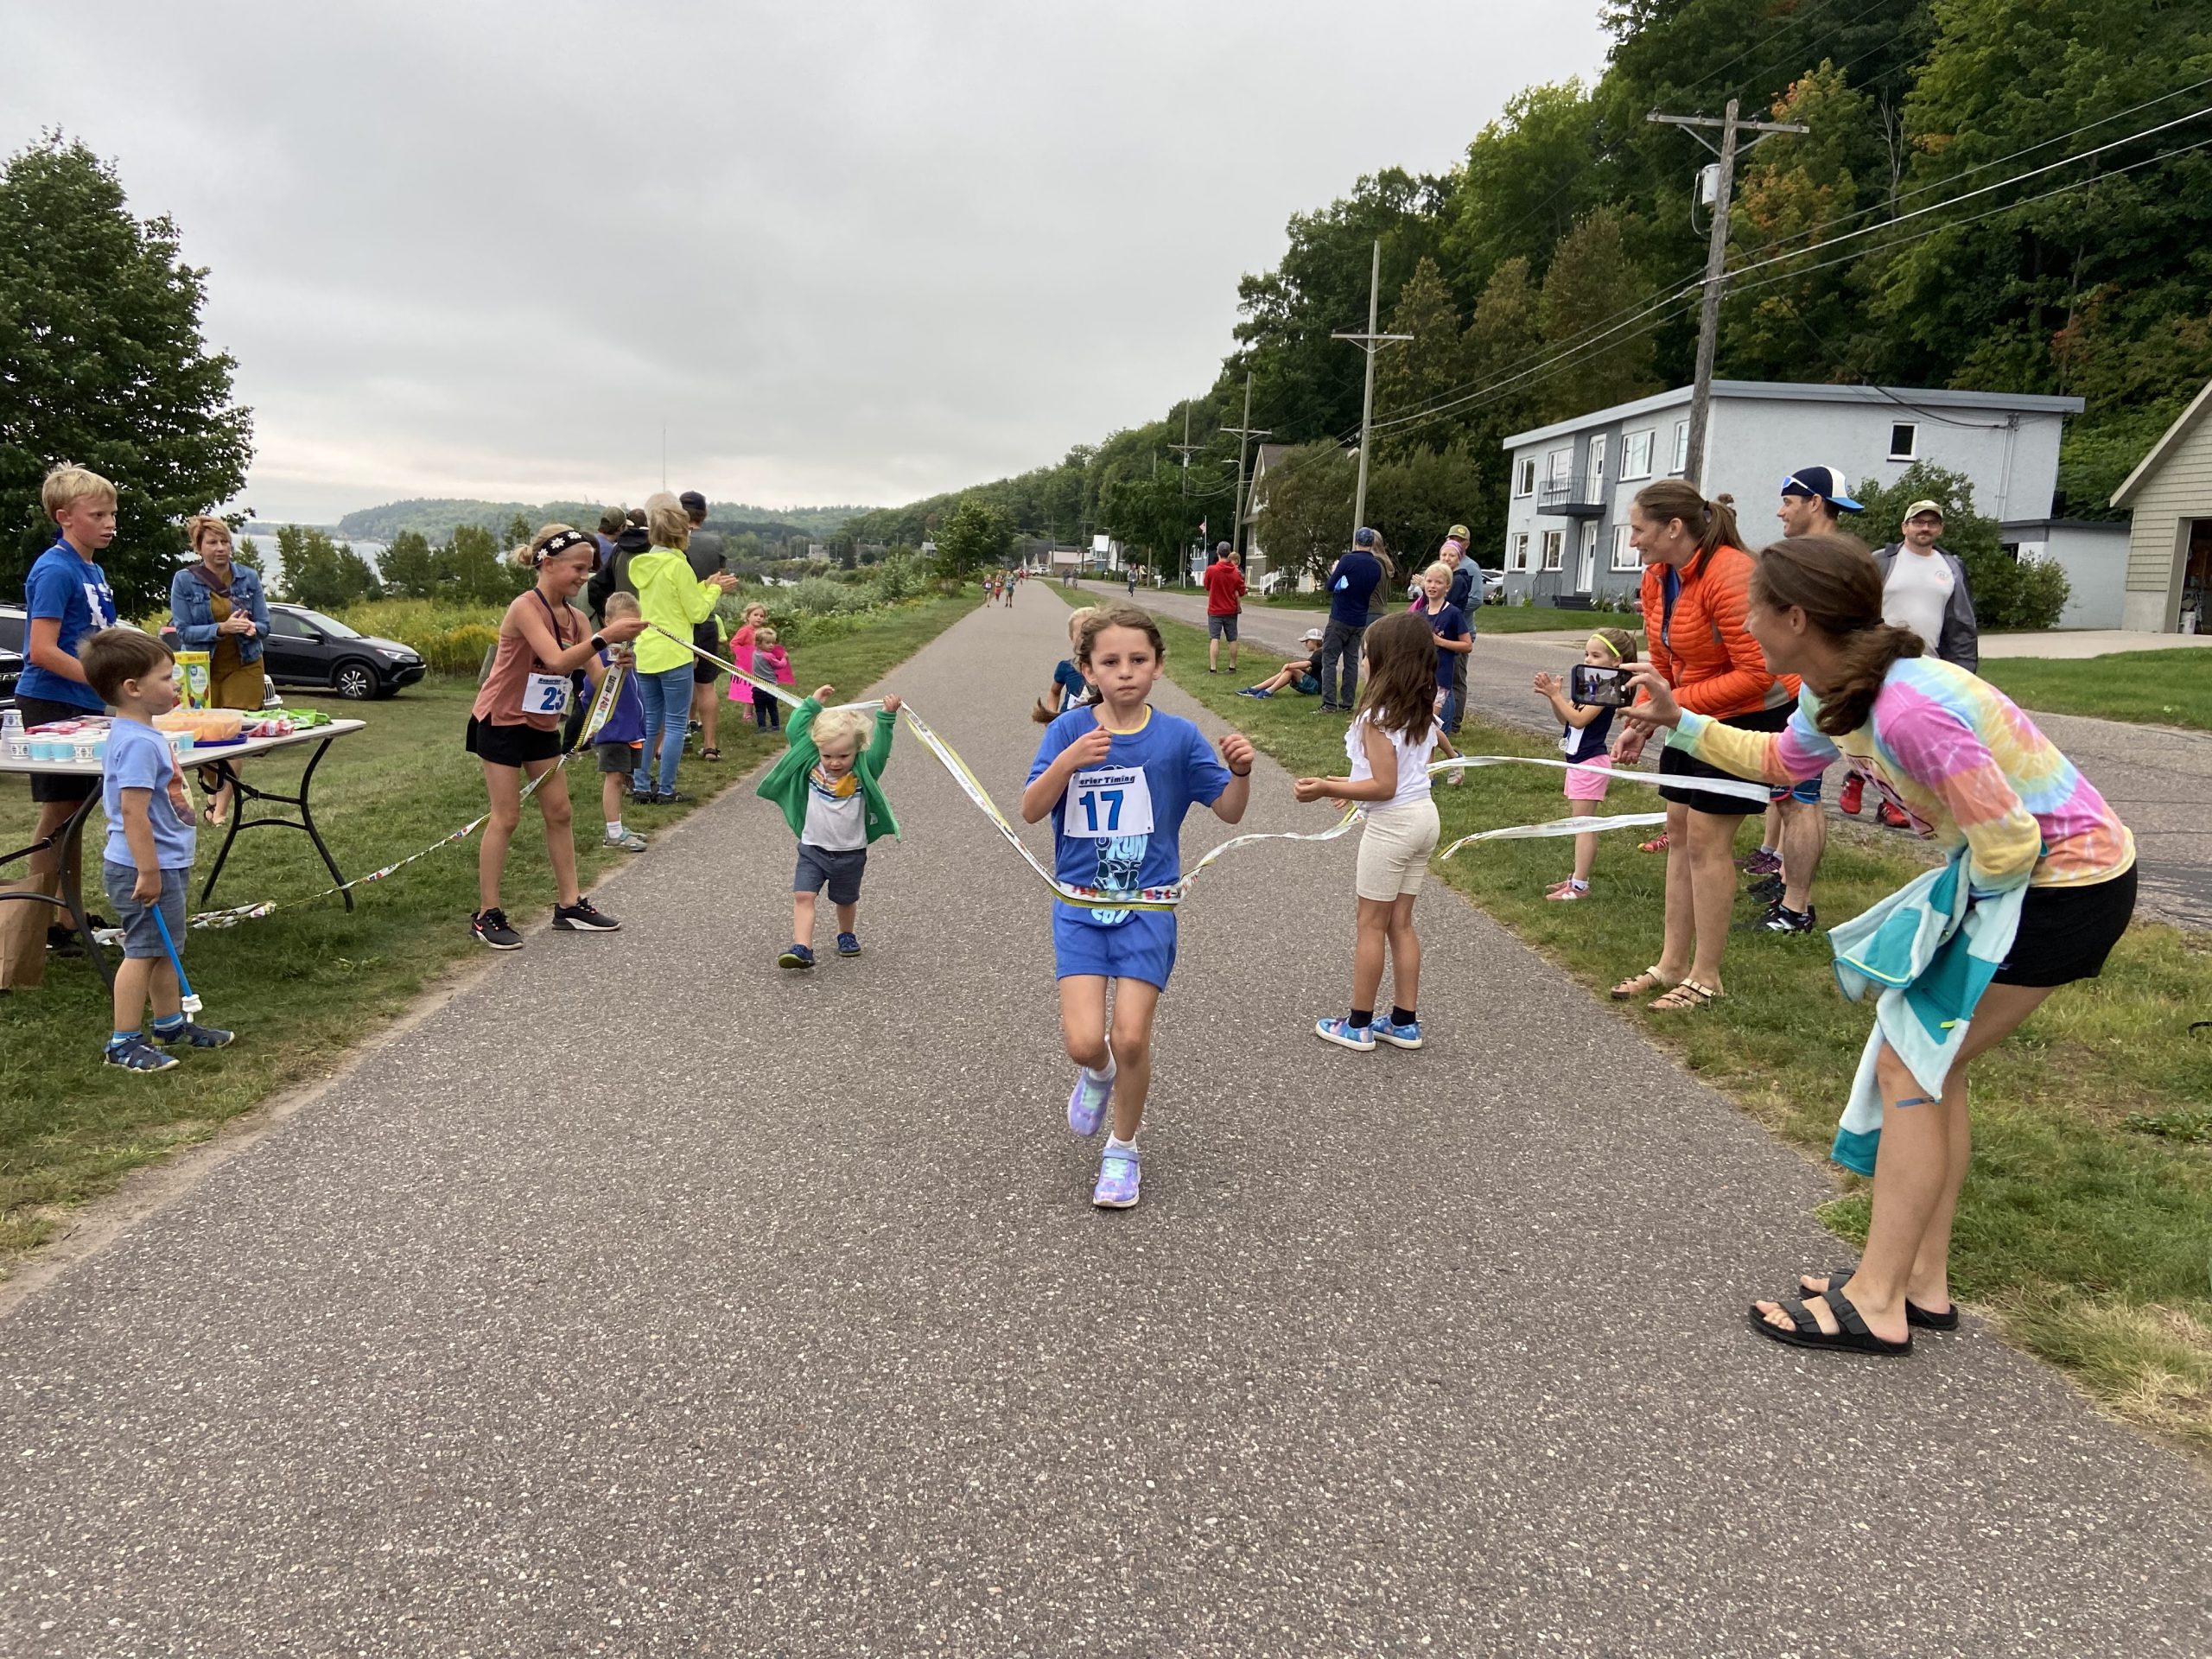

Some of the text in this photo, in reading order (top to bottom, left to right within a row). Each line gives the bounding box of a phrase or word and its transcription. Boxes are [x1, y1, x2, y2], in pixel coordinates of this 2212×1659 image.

[1104, 775, 1135, 785] Timing
[1078, 790, 1124, 831] 17
[1108, 834, 1148, 861] RUN
